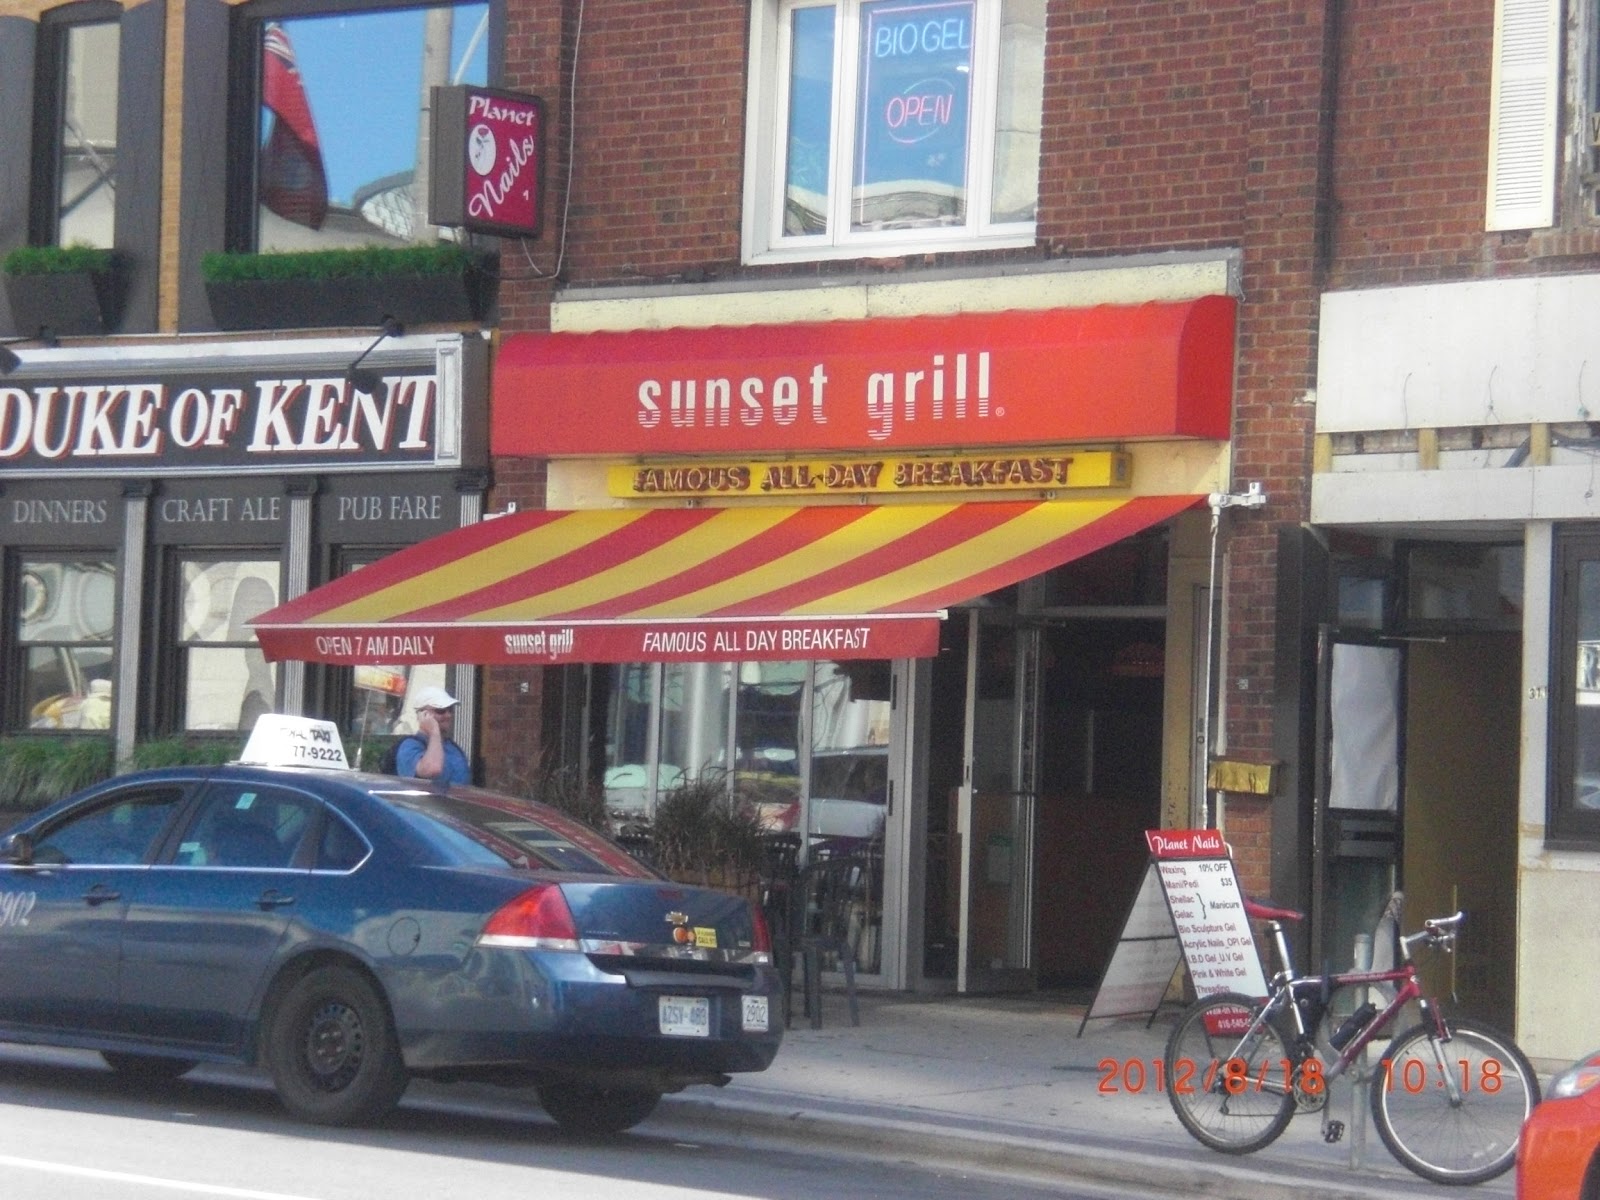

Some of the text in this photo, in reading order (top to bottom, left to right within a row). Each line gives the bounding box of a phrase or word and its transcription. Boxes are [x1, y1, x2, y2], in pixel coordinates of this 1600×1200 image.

[469, 96, 535, 126] Planet
[887, 94, 953, 128] OPEN
[469, 135, 534, 217] Nails
[638, 351, 990, 440] sunset grill
[0, 375, 436, 459] DUKE OF KENT
[894, 458, 1074, 486] BREAKFAST
[13, 500, 107, 523] DINNERS
[161, 496, 281, 522] CRAFT ALE
[339, 495, 441, 521] PUB FARE
[316, 636, 435, 655] OPEN 7 AM DAILY
[505, 629, 574, 660] sunset grill
[643, 628, 870, 652] FAMOUS ALL DAY BREAKFAST
[1152, 834, 1220, 855] Planet Nails
[1161, 866, 1186, 876] Waxing
[1199, 863, 1228, 872] 10% OFF
[1165, 880, 1200, 889] Mani/Pedi
[1220, 877, 1233, 887] $35
[0, 891, 36, 926] 902
[1170, 896, 1195, 904] Shellac
[1210, 901, 1240, 909] Manicure
[1175, 910, 1195, 919] Gelac
[1179, 922, 1237, 934] Bio Sculpture Gel
[1184, 940, 1207, 950] Acrylic
[1240, 937, 1252, 946] Gel
[1232, 952, 1244, 961] Gel
[1192, 967, 1247, 978] Pink & White Gel
[746, 1004, 766, 1023] 2902
